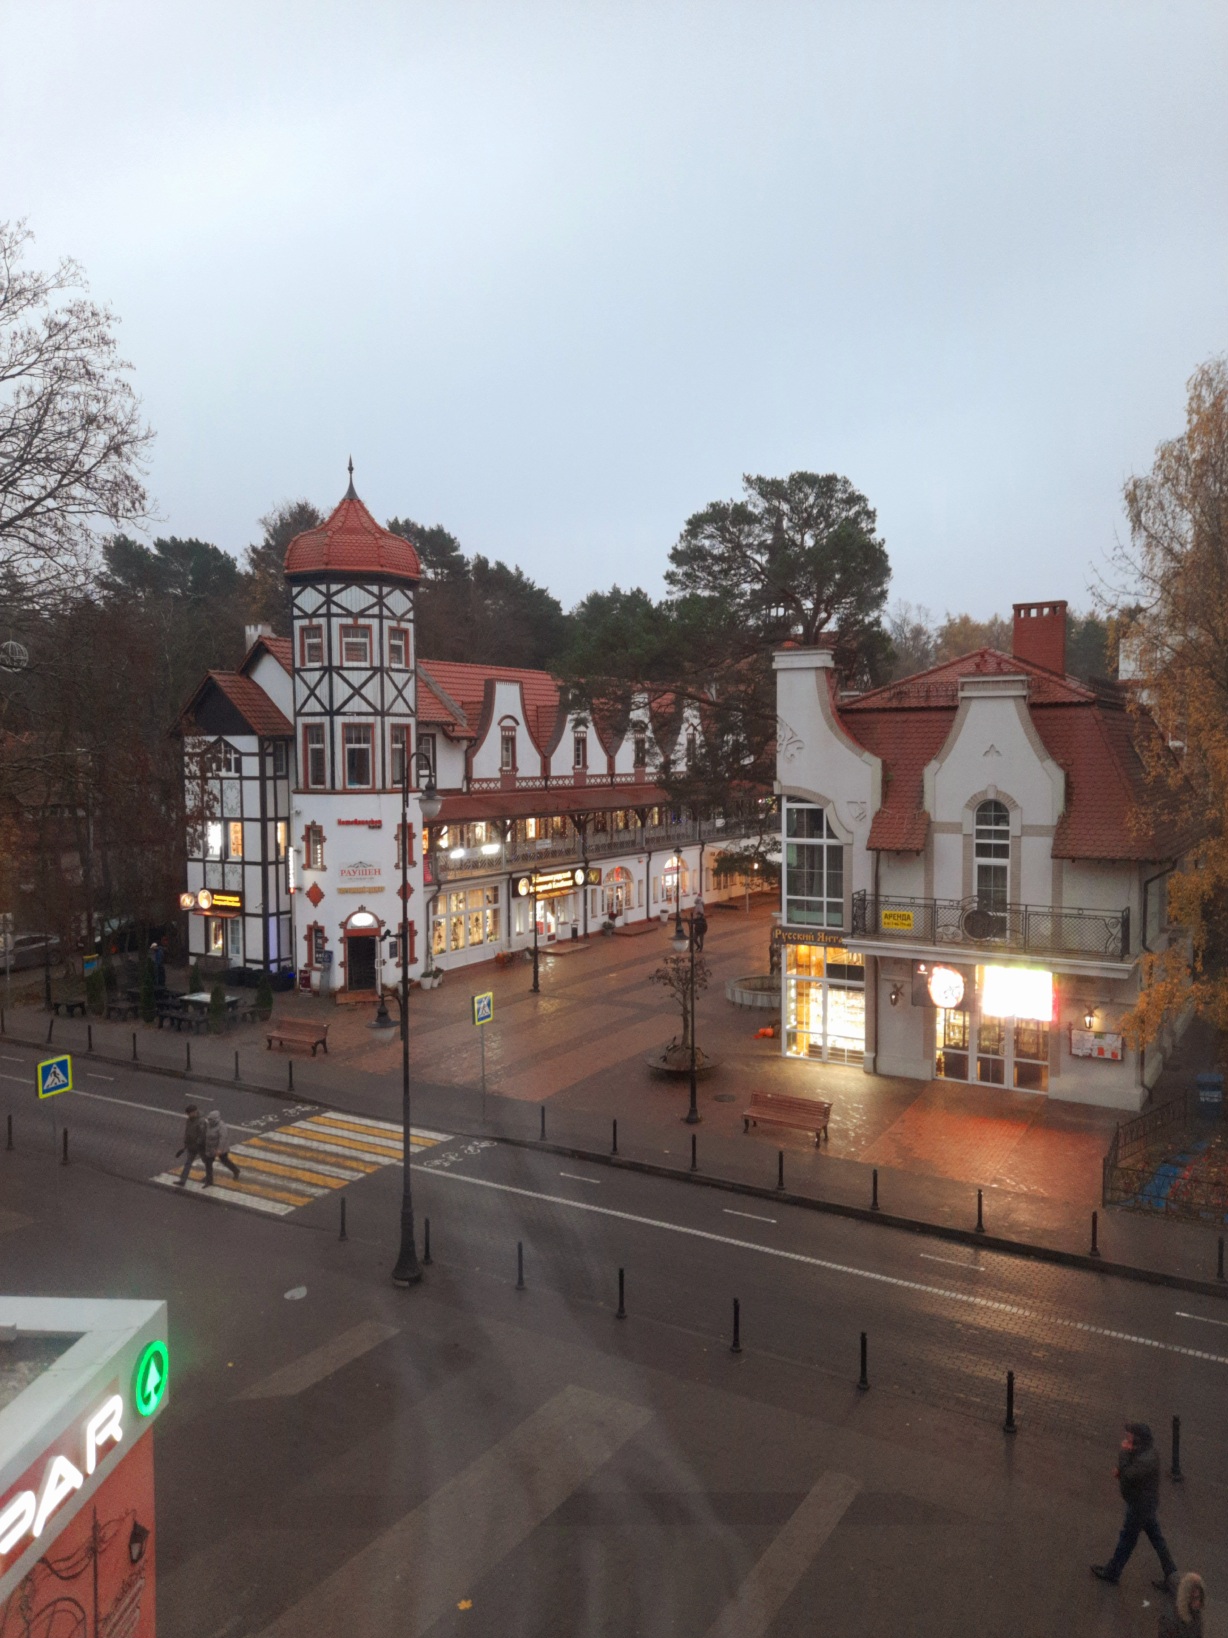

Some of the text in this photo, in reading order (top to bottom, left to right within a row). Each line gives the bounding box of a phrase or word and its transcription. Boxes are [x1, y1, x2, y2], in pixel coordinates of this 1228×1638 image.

[340, 868, 381, 877] РАУШЕН
[884, 913, 912, 921] АРЕНДА
[774, 929, 843, 943] Русский Янта
[0, 1394, 123, 1554] PAR
